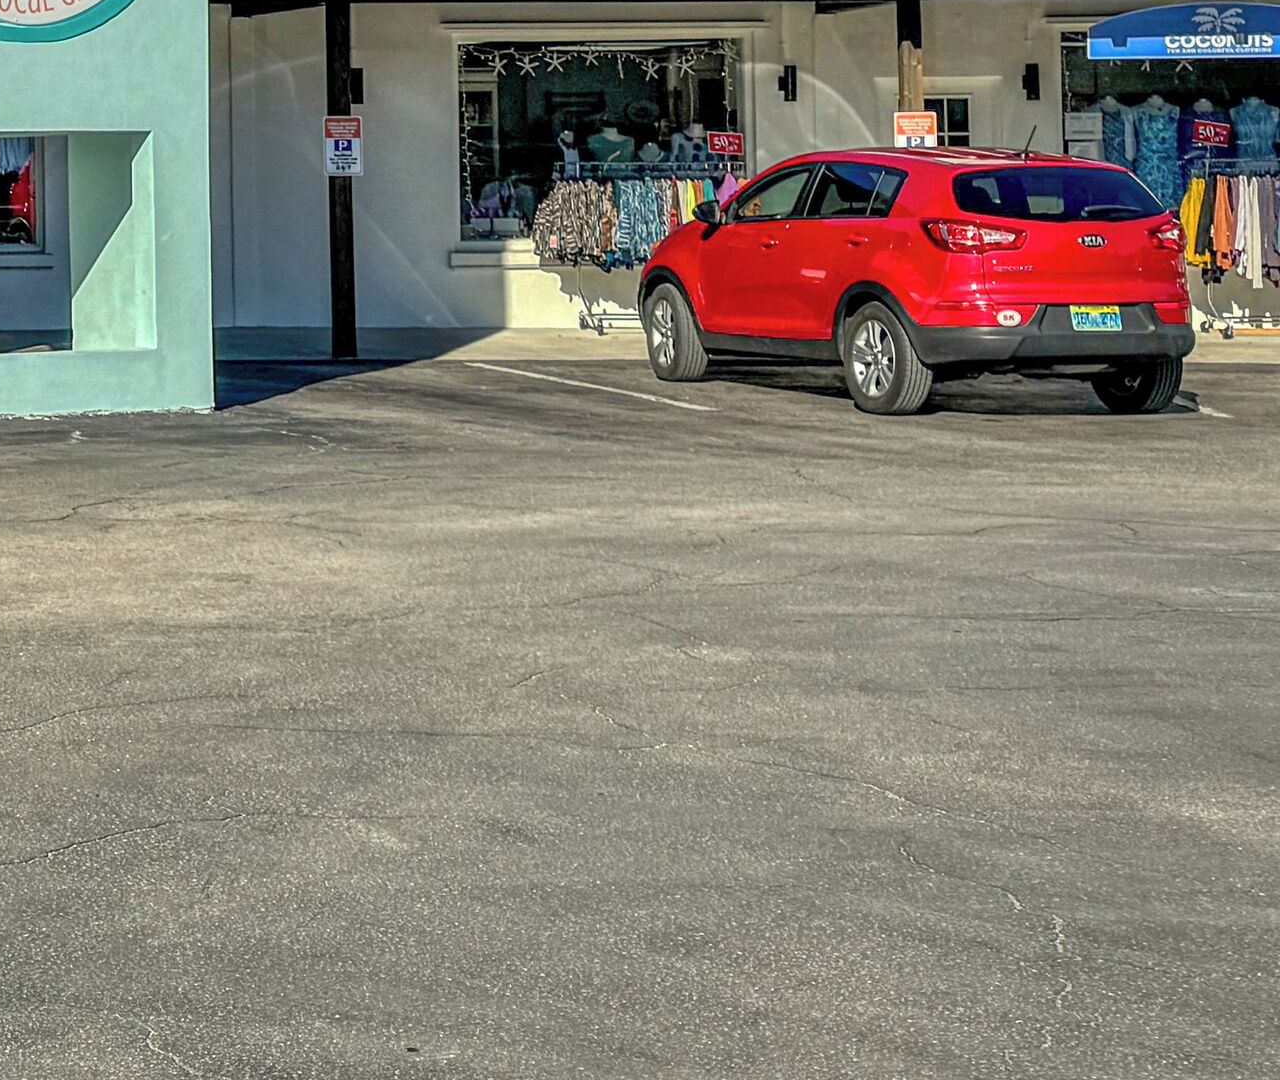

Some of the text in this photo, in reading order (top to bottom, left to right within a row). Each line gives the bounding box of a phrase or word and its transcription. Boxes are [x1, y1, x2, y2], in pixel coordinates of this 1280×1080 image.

[1165, 32, 1274, 49] COCONUTS
[339, 141, 348, 151] P
[911, 137, 921, 147] P
[1083, 236, 1104, 246] KIA
